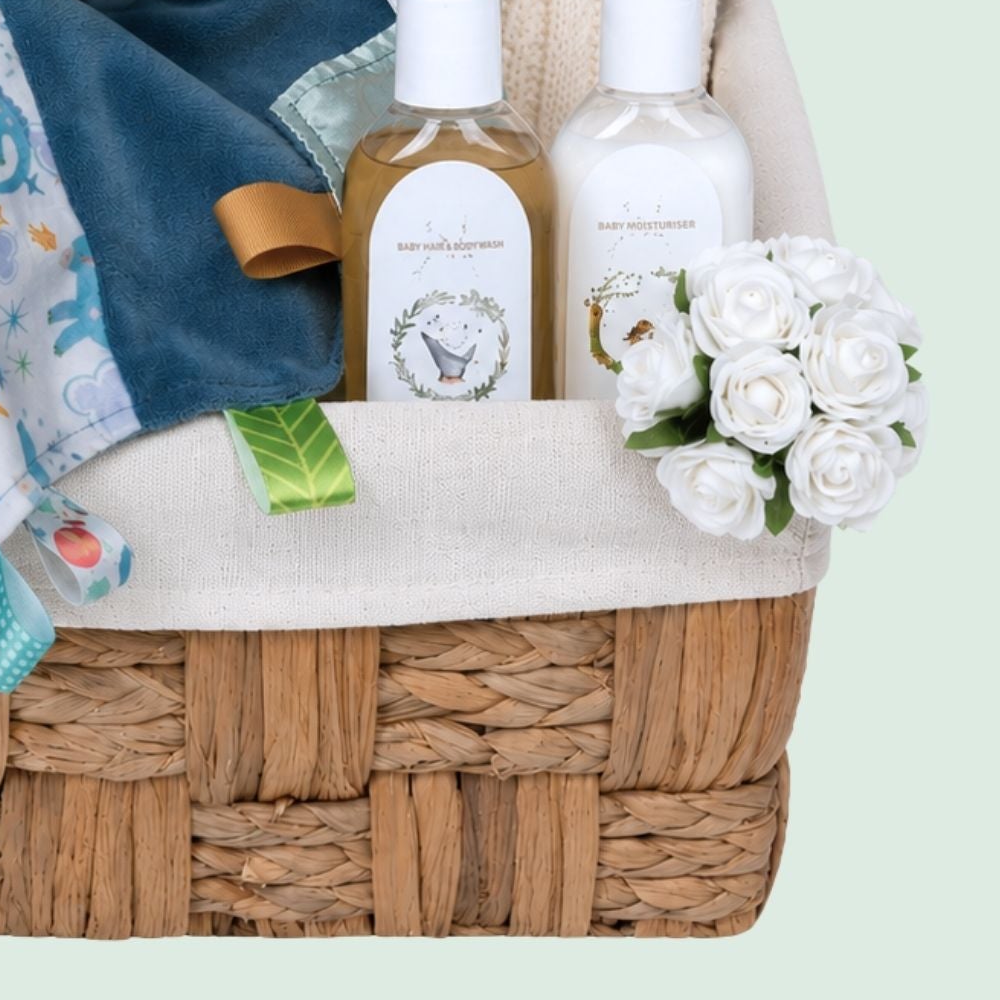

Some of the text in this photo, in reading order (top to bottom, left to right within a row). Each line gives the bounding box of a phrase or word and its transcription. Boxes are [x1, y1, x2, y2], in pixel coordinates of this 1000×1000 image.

[597, 220, 696, 231] BABY MOISTURISER
[396, 242, 421, 252] BABY
